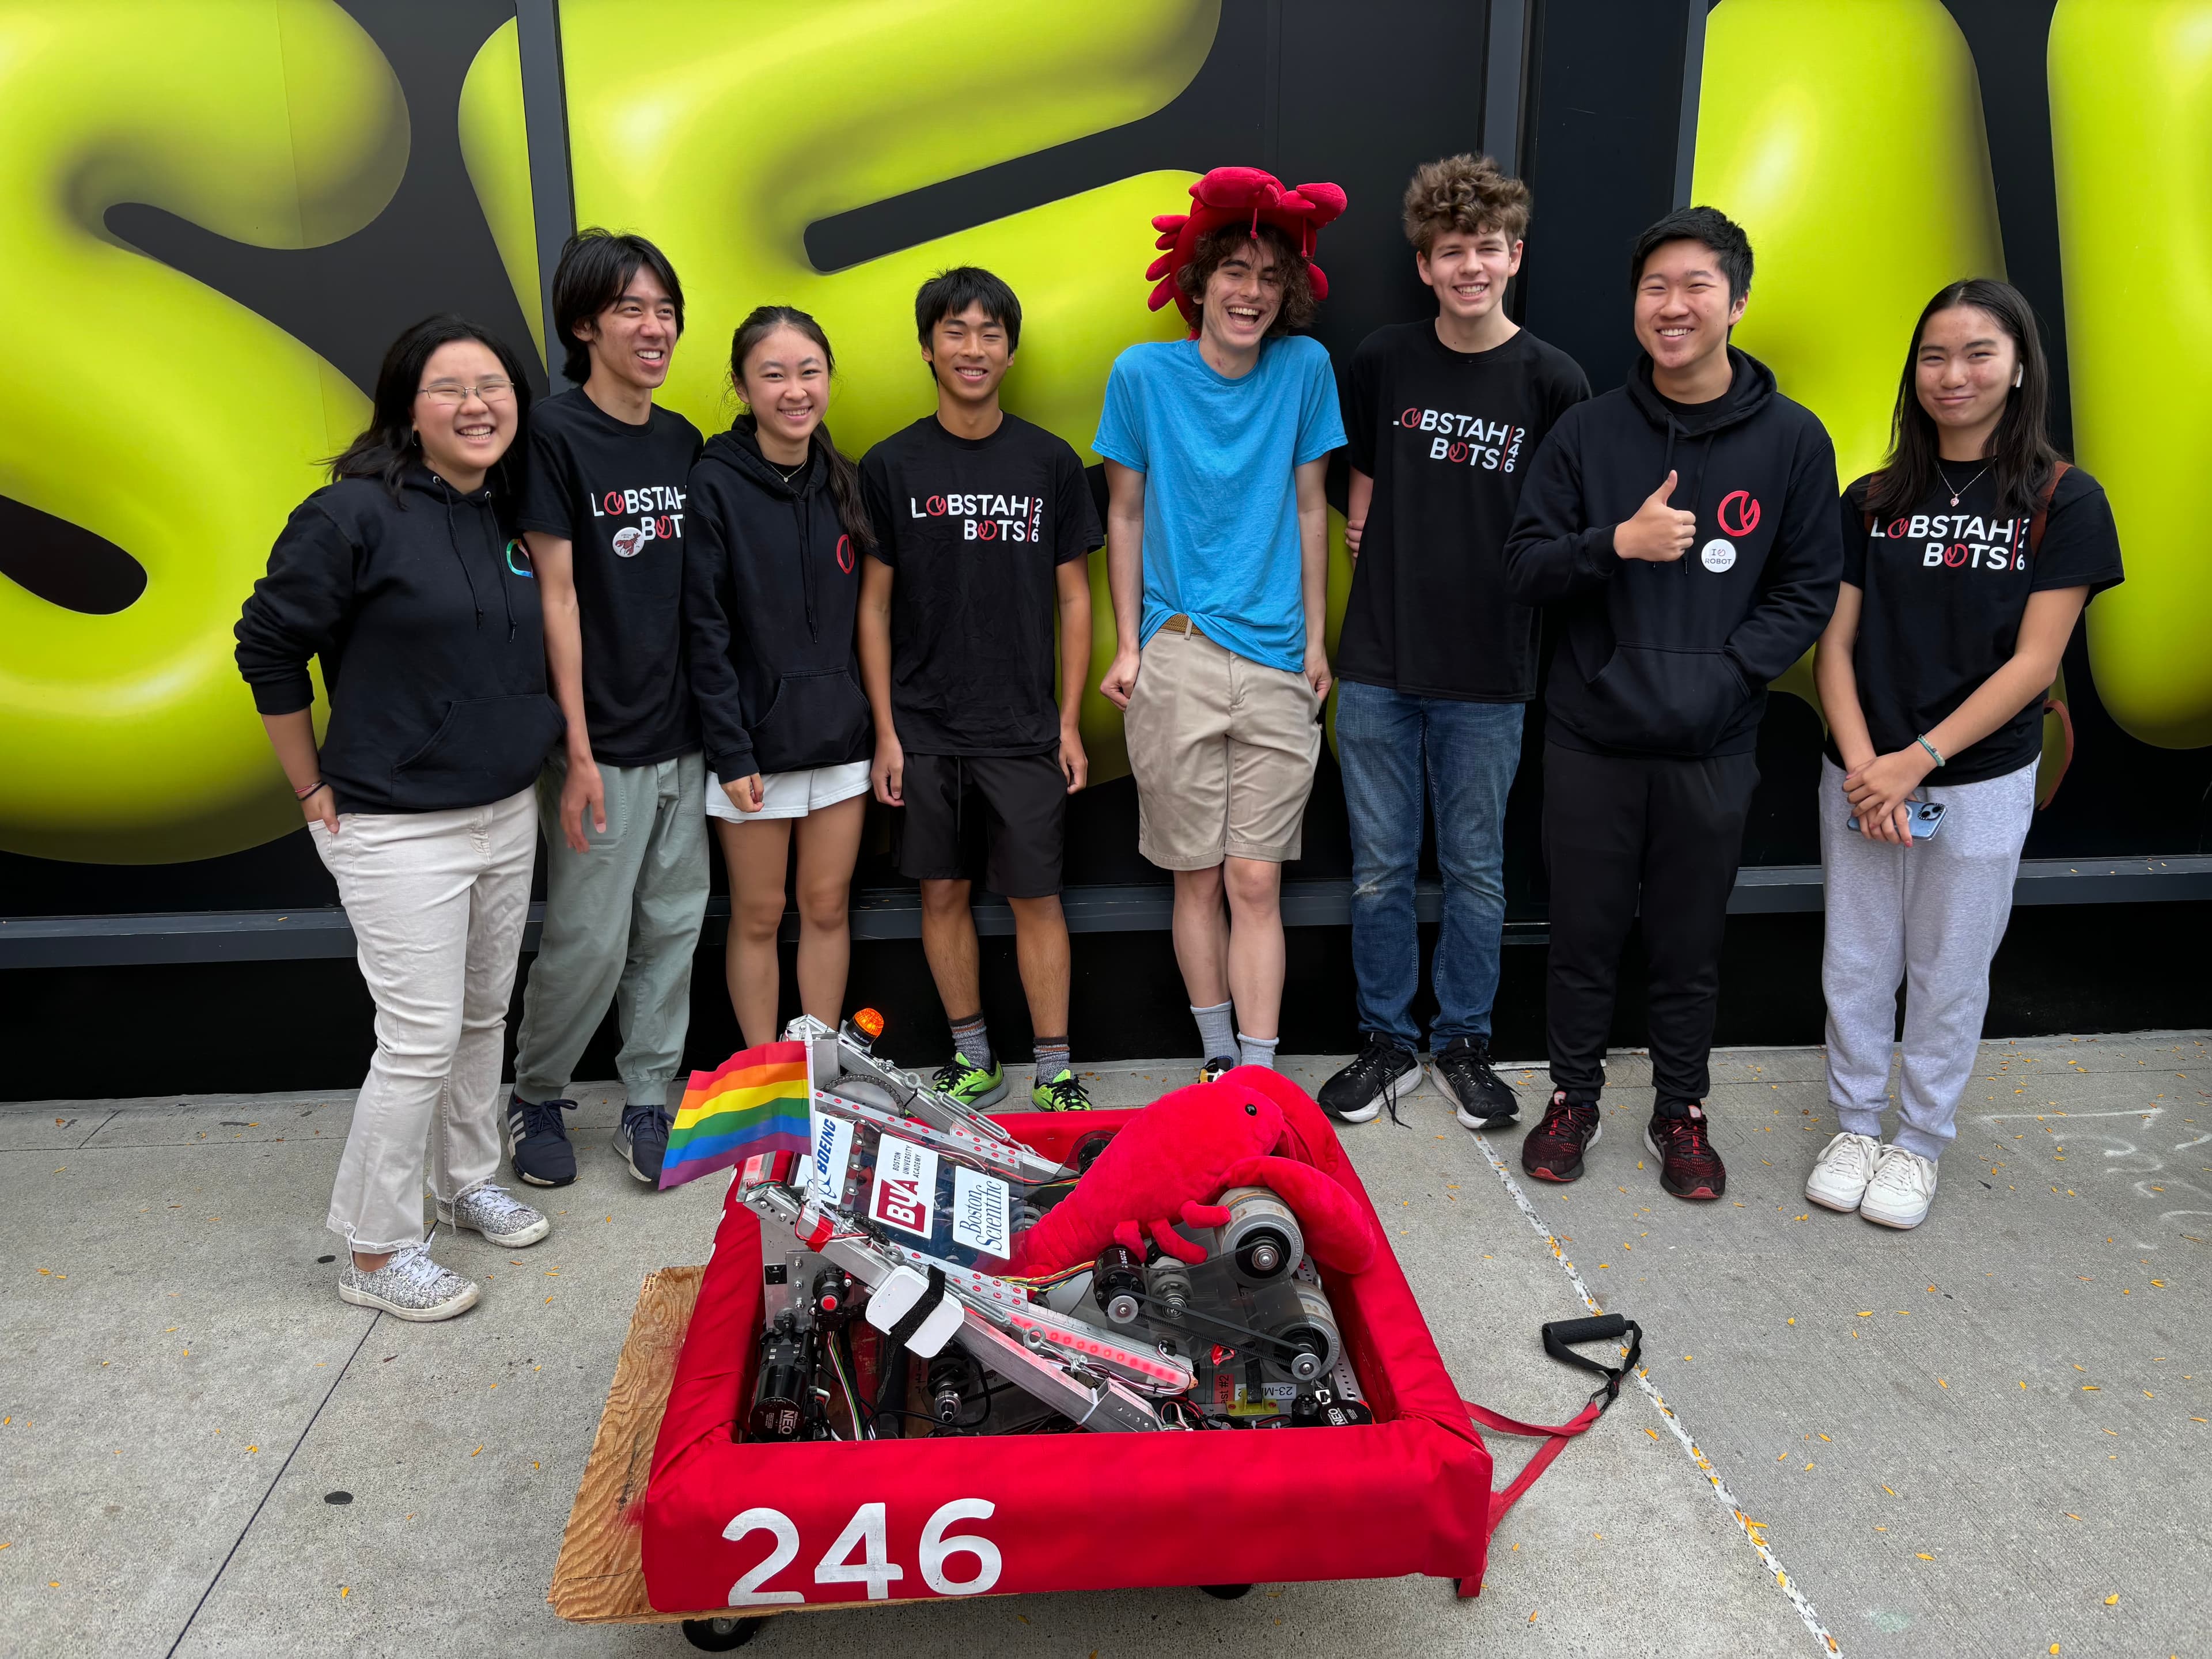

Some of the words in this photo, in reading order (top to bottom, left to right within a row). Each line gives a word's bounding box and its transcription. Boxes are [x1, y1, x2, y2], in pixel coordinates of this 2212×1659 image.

[1393, 407, 1509, 445] OBSTAH
[1430, 437, 1500, 469] BOTS
[1504, 427, 1525, 473] 246
[911, 494, 1029, 518] LOBSTAH
[1031, 498, 1044, 543] 246
[964, 519, 1025, 542] BOTS
[1870, 515, 2013, 543] LOBSTAH
[1923, 543, 2009, 570] BOTS
[817, 1118, 836, 1175] BOEING
[892, 1151, 902, 1172] BOSTON
[903, 1145, 913, 1175] UNIVERSITY
[912, 1153, 922, 1179] ACADEMY
[887, 1179, 919, 1225] BUA
[959, 1189, 983, 1235] Boston
[975, 1181, 1003, 1251] Scientific
[1219, 1374, 1229, 1388] #2
[781, 1410, 795, 1435] NEO
[1328, 1408, 1346, 1426] NEO
[722, 1498, 1002, 1607] 246
